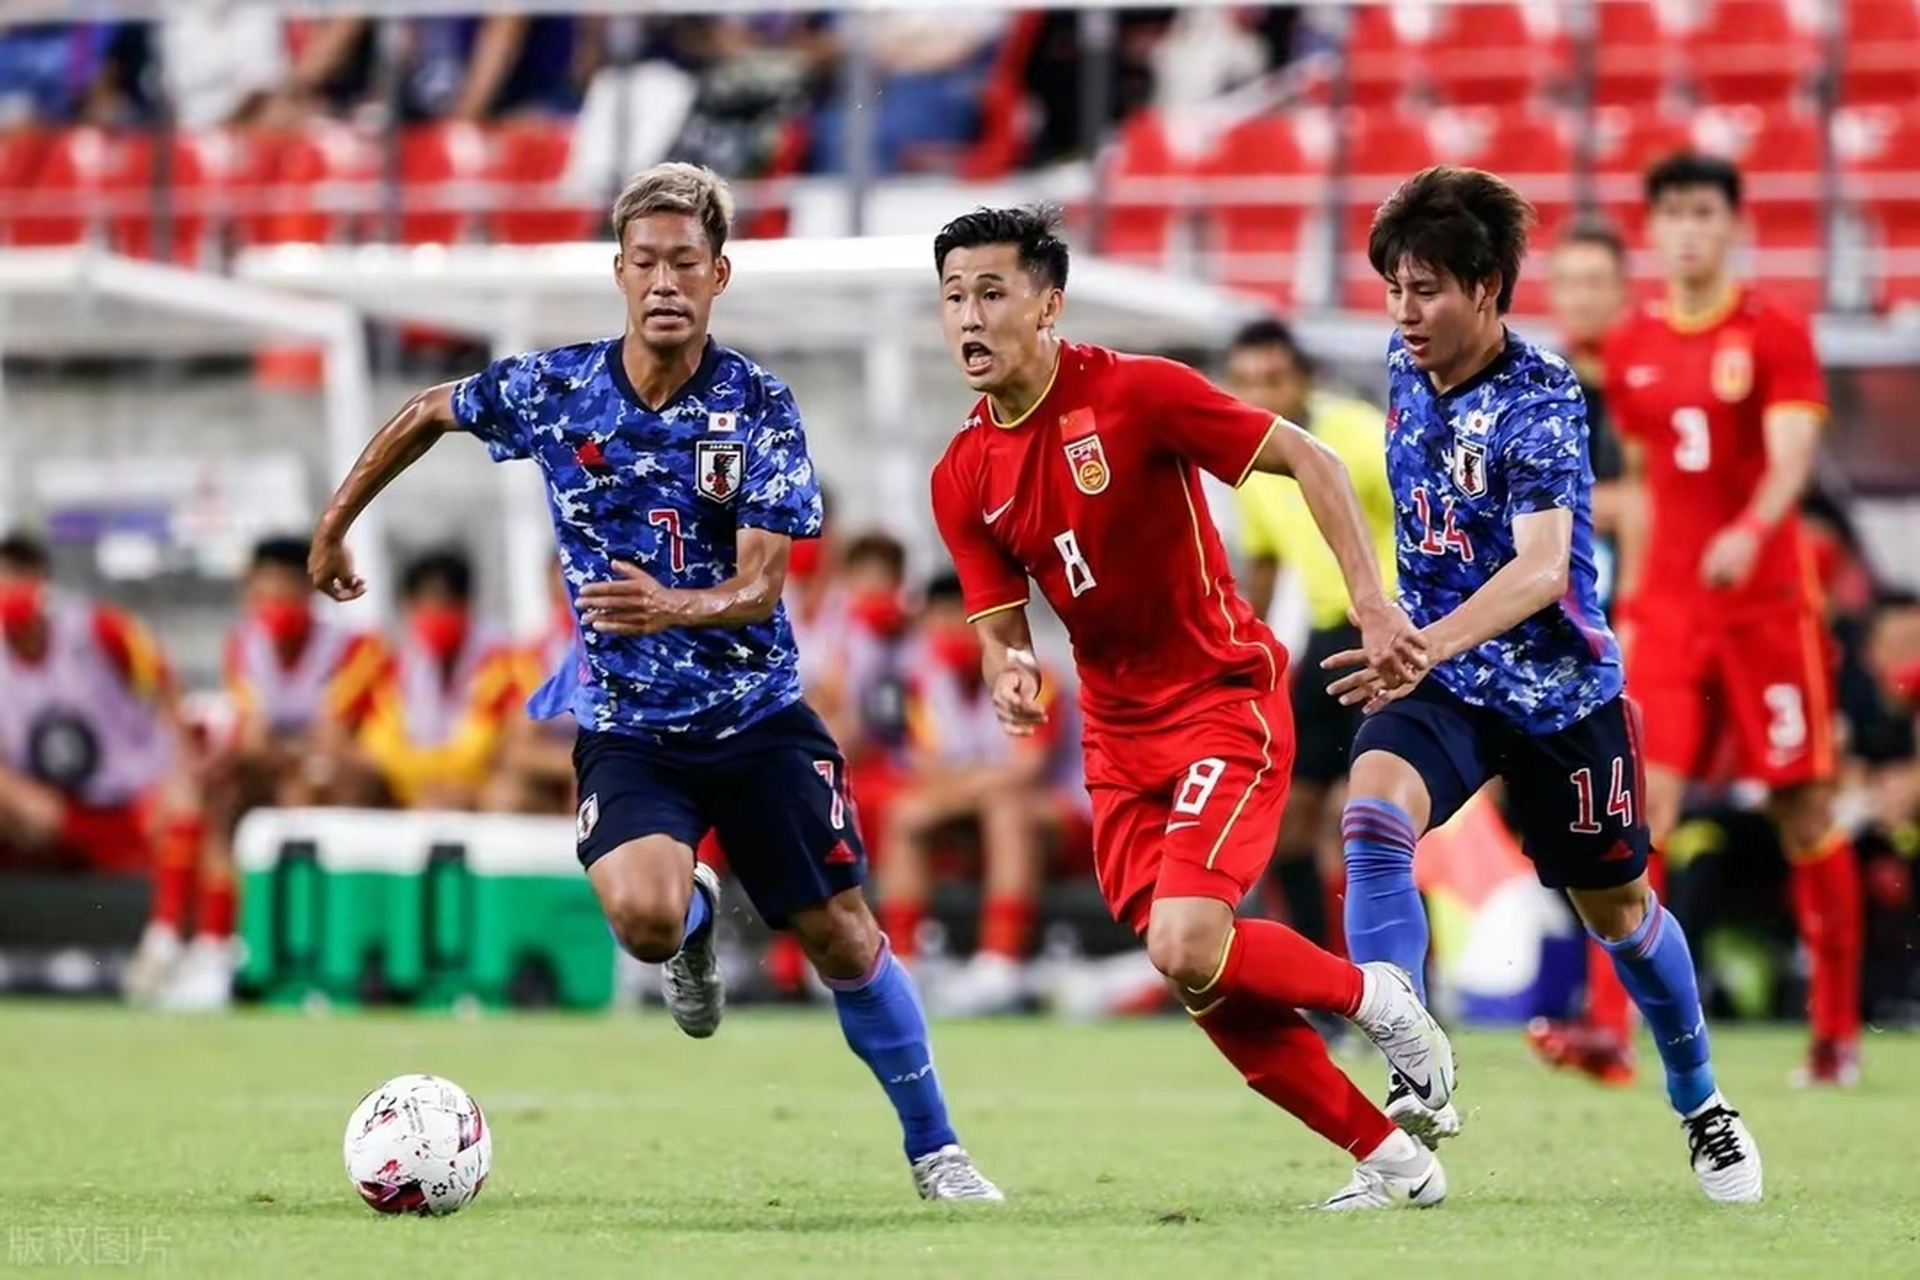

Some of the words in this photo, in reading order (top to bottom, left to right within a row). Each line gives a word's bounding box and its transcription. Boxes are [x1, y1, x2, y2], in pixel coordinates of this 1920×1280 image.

[1671, 406, 1711, 472] 3
[648, 508, 685, 573] 7
[1411, 486, 1475, 562] 14
[1053, 528, 1098, 598] 8
[1763, 683, 1807, 748] 3
[812, 760, 844, 830] 7
[1174, 756, 1227, 816] 8
[1569, 756, 1633, 834] 14
